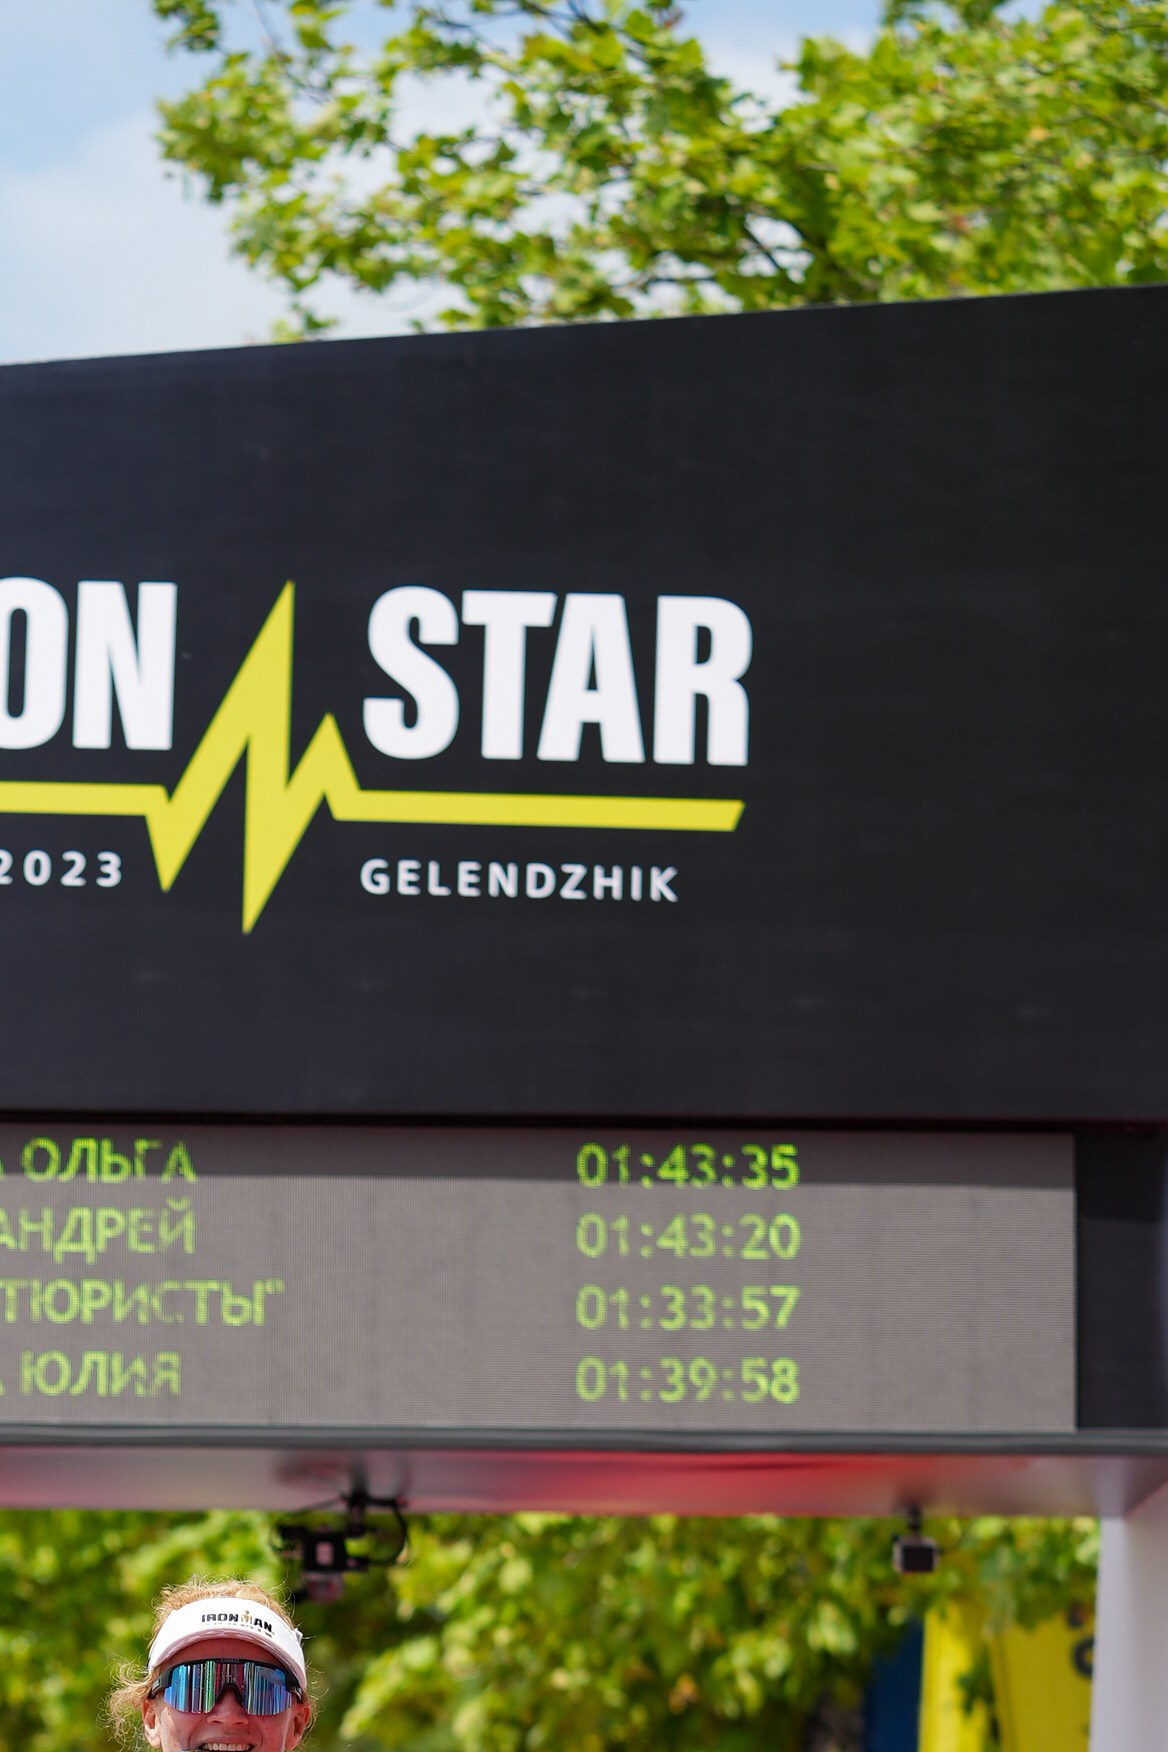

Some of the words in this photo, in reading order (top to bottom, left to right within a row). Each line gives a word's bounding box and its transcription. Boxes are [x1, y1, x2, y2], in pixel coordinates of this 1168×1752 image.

[362, 585, 753, 766] STAR
[360, 858, 679, 902] GELENDZHIK
[22, 1137, 198, 1184] ОЛЬГА
[576, 1143, 801, 1189] 01:43:35
[576, 1213, 802, 1259] 01:43:20
[576, 1285, 801, 1331] 01:33:57
[21, 1350, 182, 1397] ЮЛИЯ
[576, 1357, 801, 1404] 01:39:58
